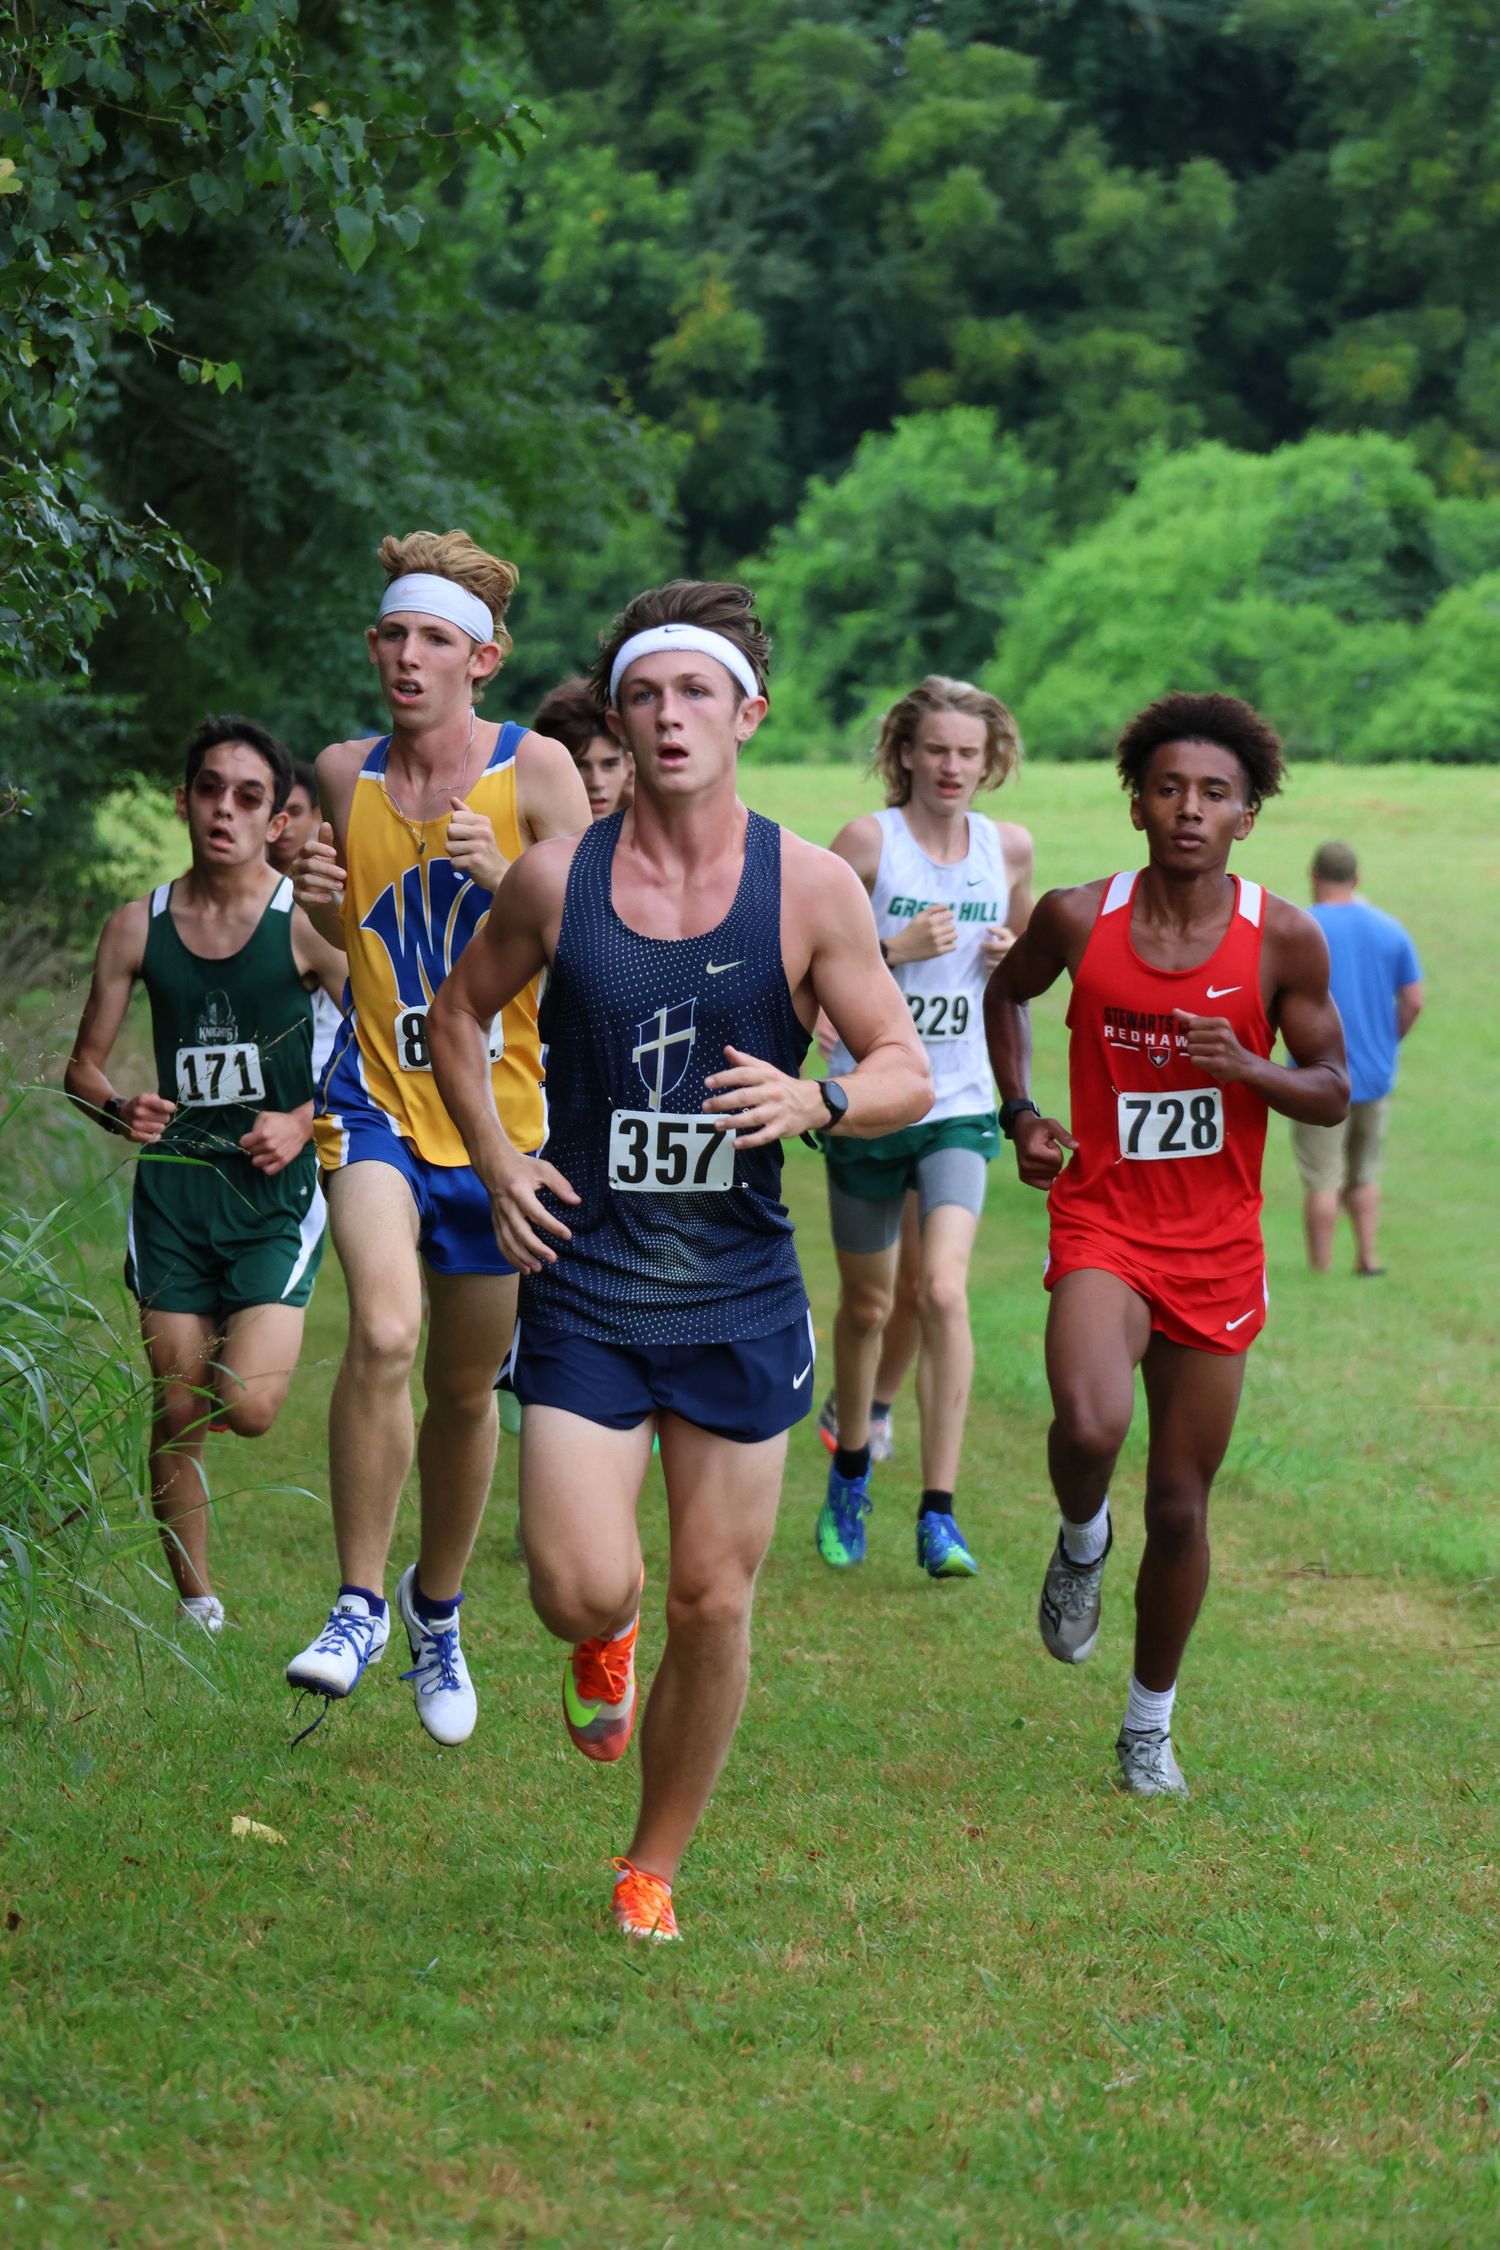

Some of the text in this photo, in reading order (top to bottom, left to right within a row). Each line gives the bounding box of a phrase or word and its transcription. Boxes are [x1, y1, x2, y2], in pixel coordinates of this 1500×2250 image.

[888, 897, 996, 921] GRE HILL
[199, 1027, 234, 1041] KNIGHTS
[907, 995, 969, 1035] 229
[1104, 1007, 1174, 1034] STEWARTS
[183, 1051, 258, 1101] 171
[1125, 1095, 1218, 1153] 728
[616, 1118, 728, 1185] 357
